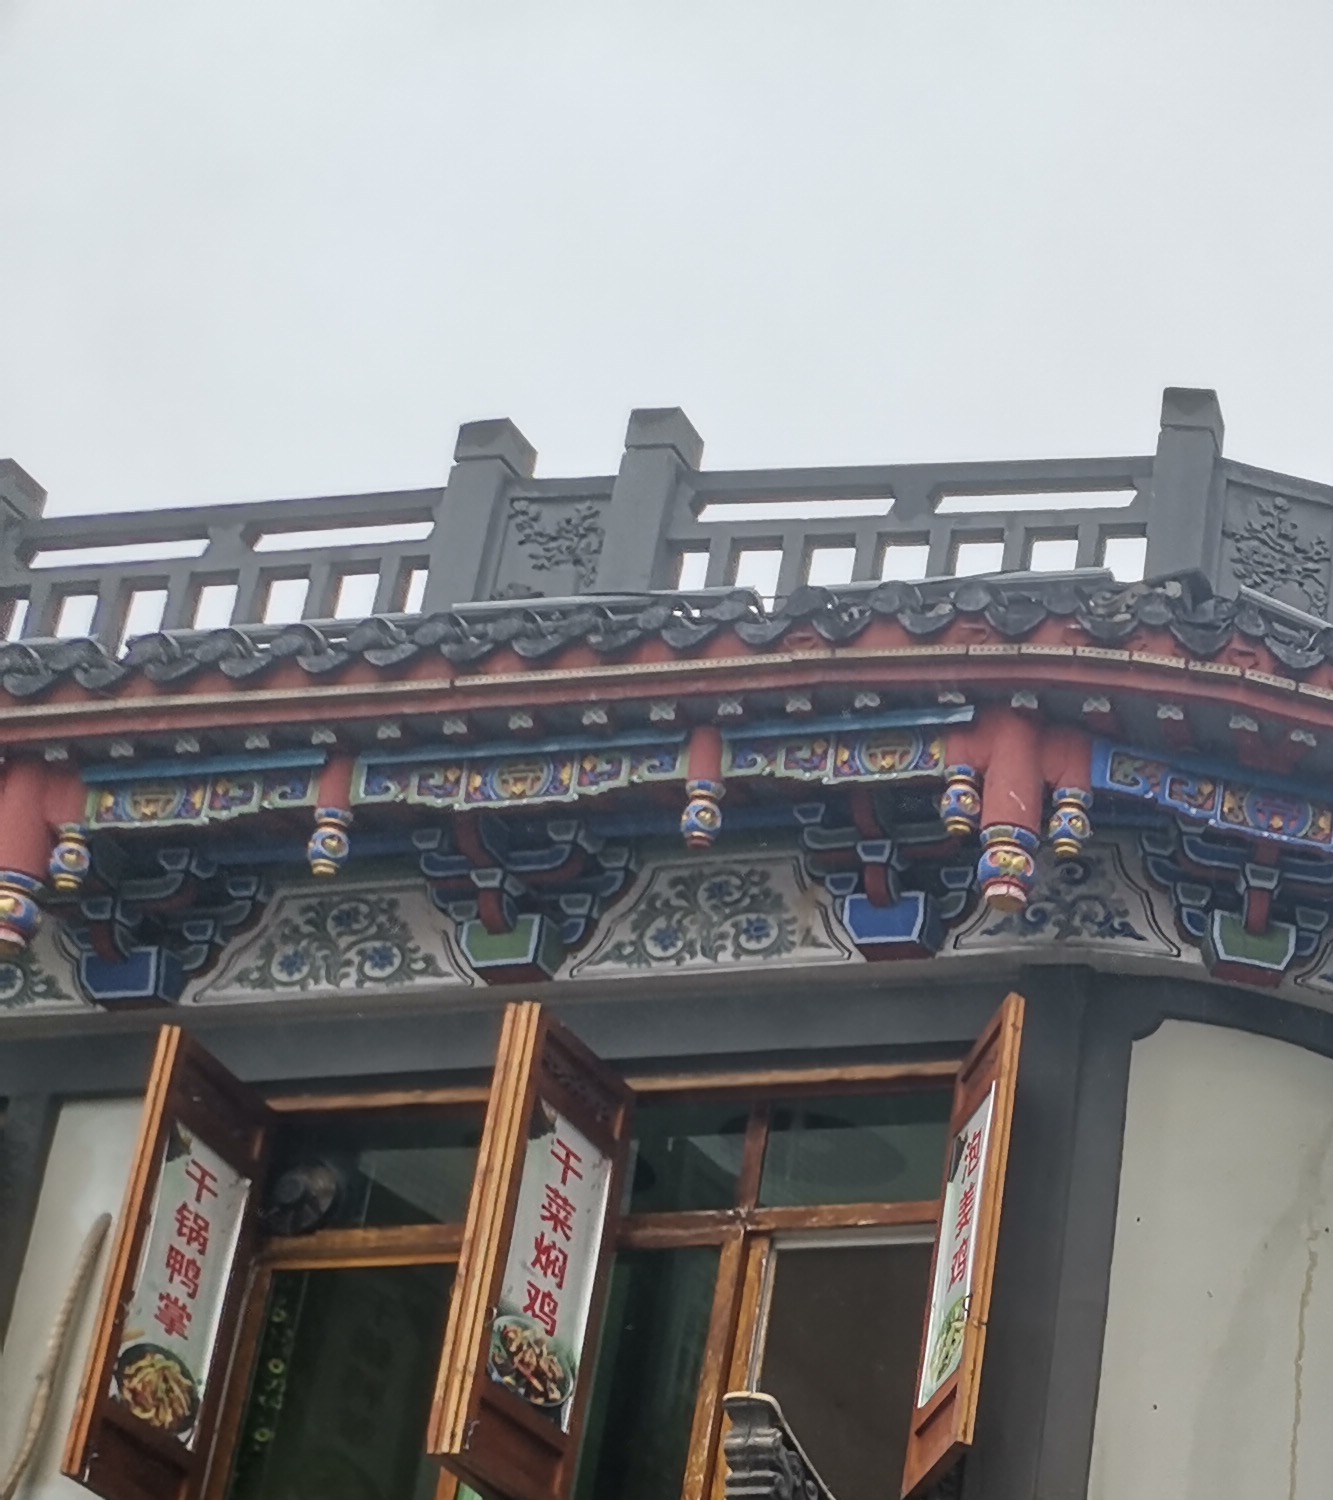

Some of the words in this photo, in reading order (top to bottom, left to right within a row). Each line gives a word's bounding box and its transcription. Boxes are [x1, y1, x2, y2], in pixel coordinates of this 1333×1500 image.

[154, 1158, 218, 1340] 干锅鸭掌
[522, 1137, 583, 1337] 干菜焖鸡
